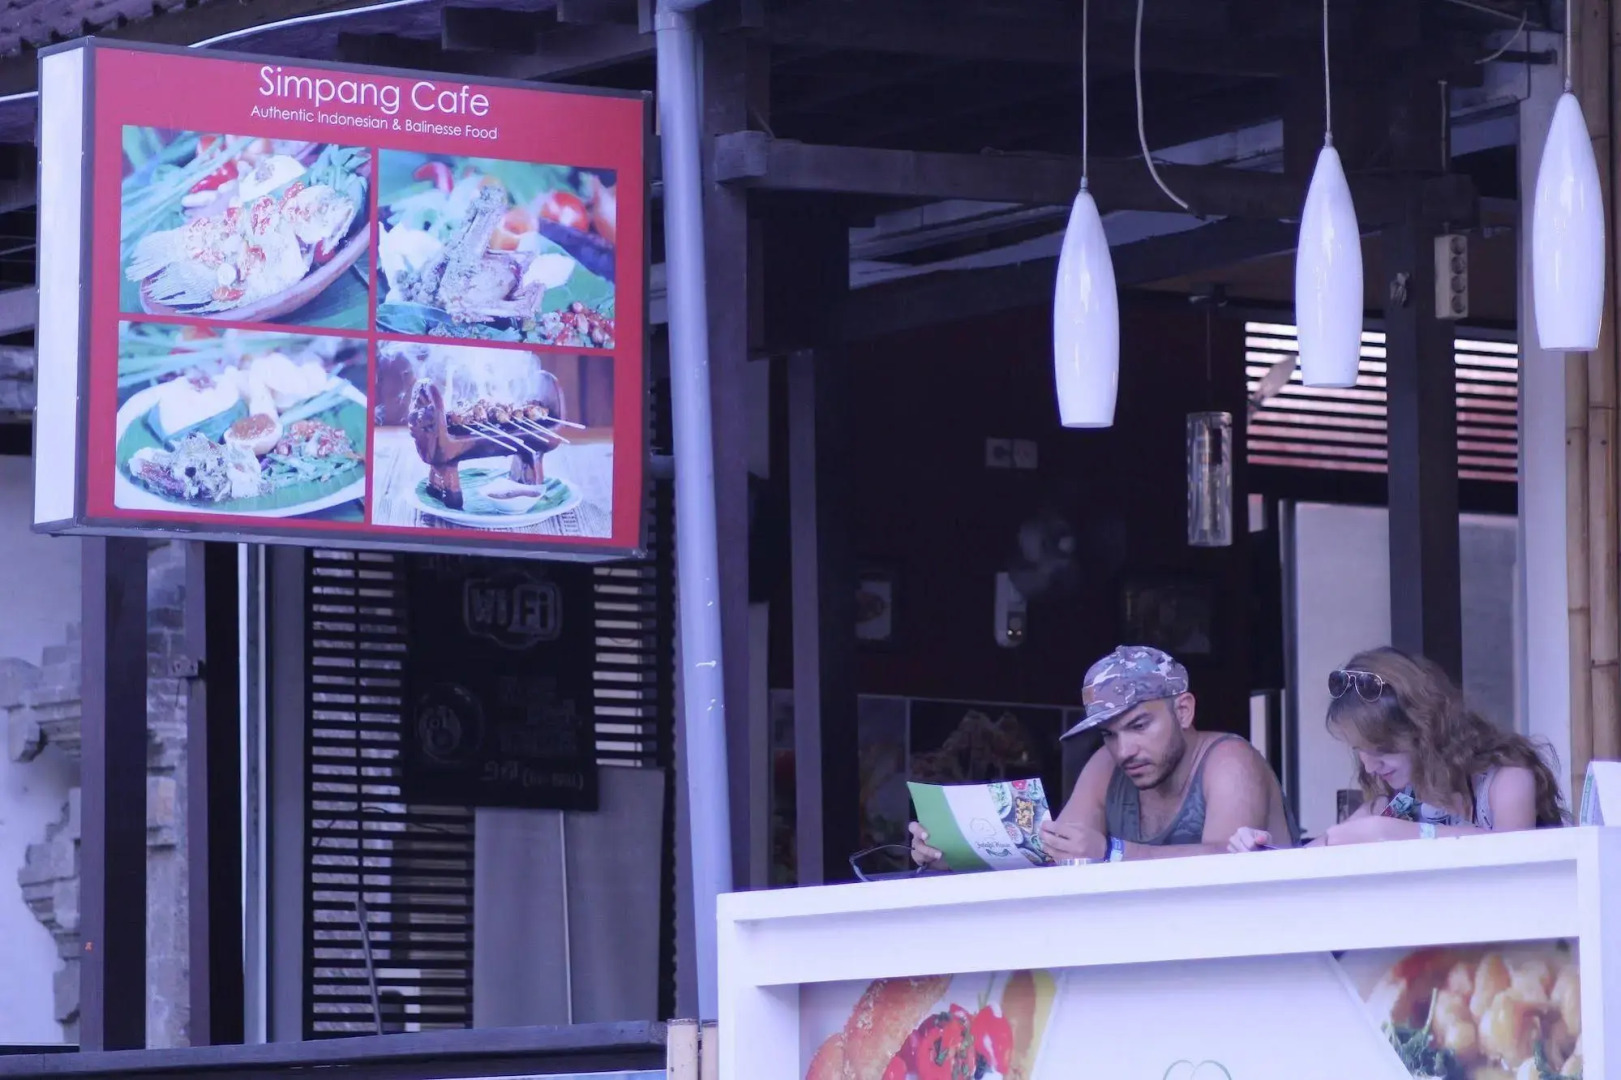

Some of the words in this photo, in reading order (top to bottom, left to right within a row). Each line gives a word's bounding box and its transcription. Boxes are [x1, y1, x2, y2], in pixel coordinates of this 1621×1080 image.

[258, 66, 400, 115] Simpang
[411, 81, 490, 117] Cafe
[250, 105, 314, 123] Authentic
[317, 111, 388, 130] Indonesian
[392, 118, 402, 131] &
[405, 119, 462, 136] Balinesse
[465, 125, 498, 140] Food
